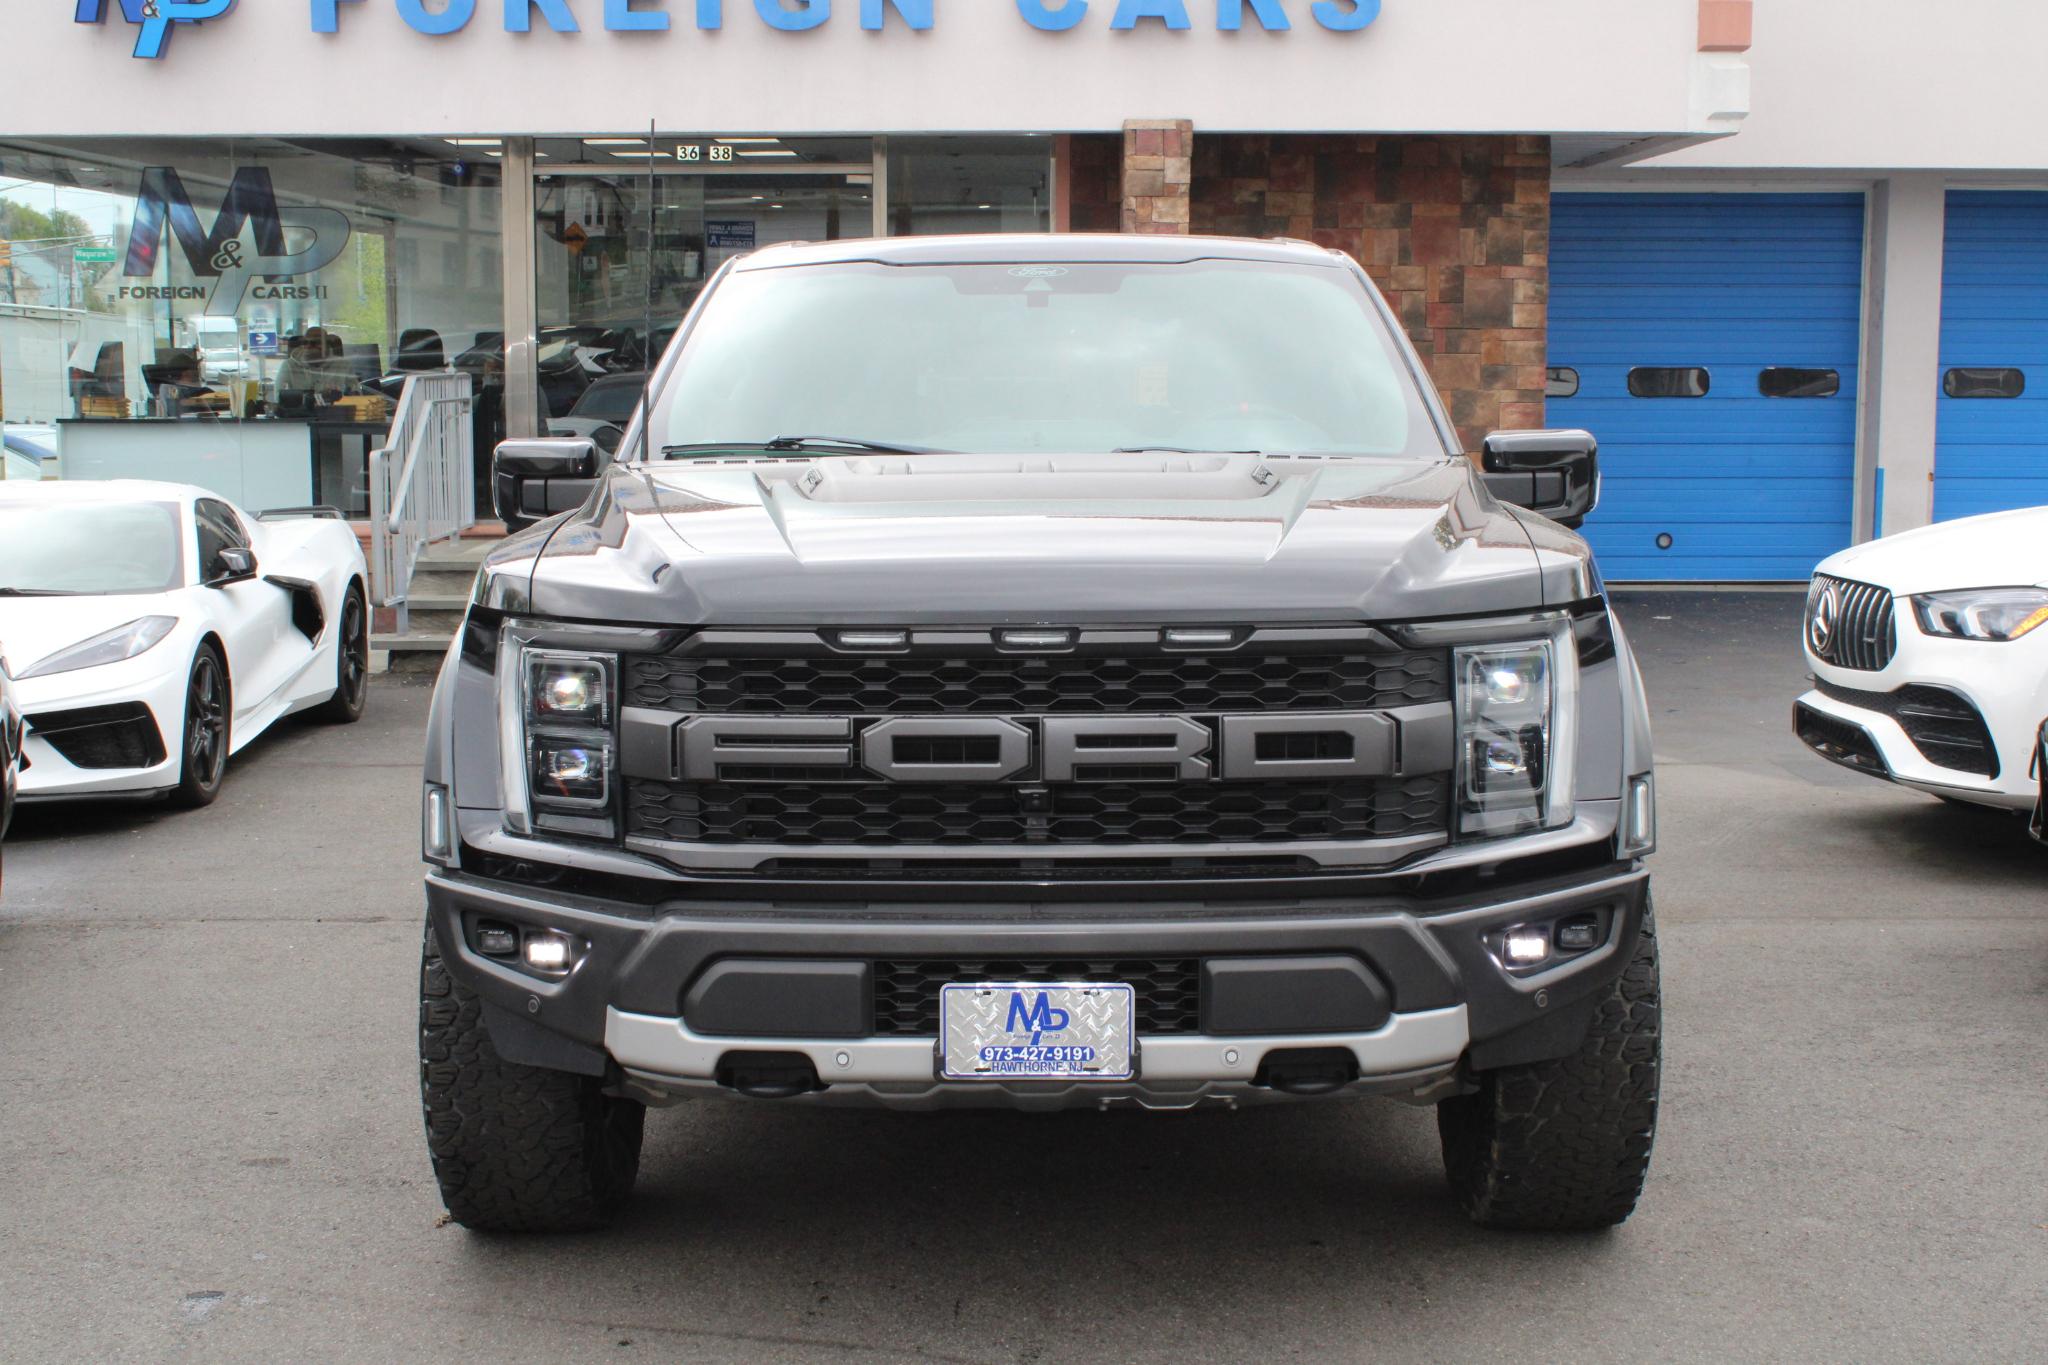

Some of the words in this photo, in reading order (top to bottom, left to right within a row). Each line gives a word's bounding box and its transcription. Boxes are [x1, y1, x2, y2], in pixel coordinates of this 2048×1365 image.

[679, 146, 698, 160] 36
[711, 147, 731, 160] 38
[119, 286, 206, 300] FOREIGN
[252, 286, 309, 300] CARS
[678, 711, 1396, 781] FORD
[984, 1047, 1091, 1061] 973-427-9191
[1069, 1061, 1083, 1072] NJ
